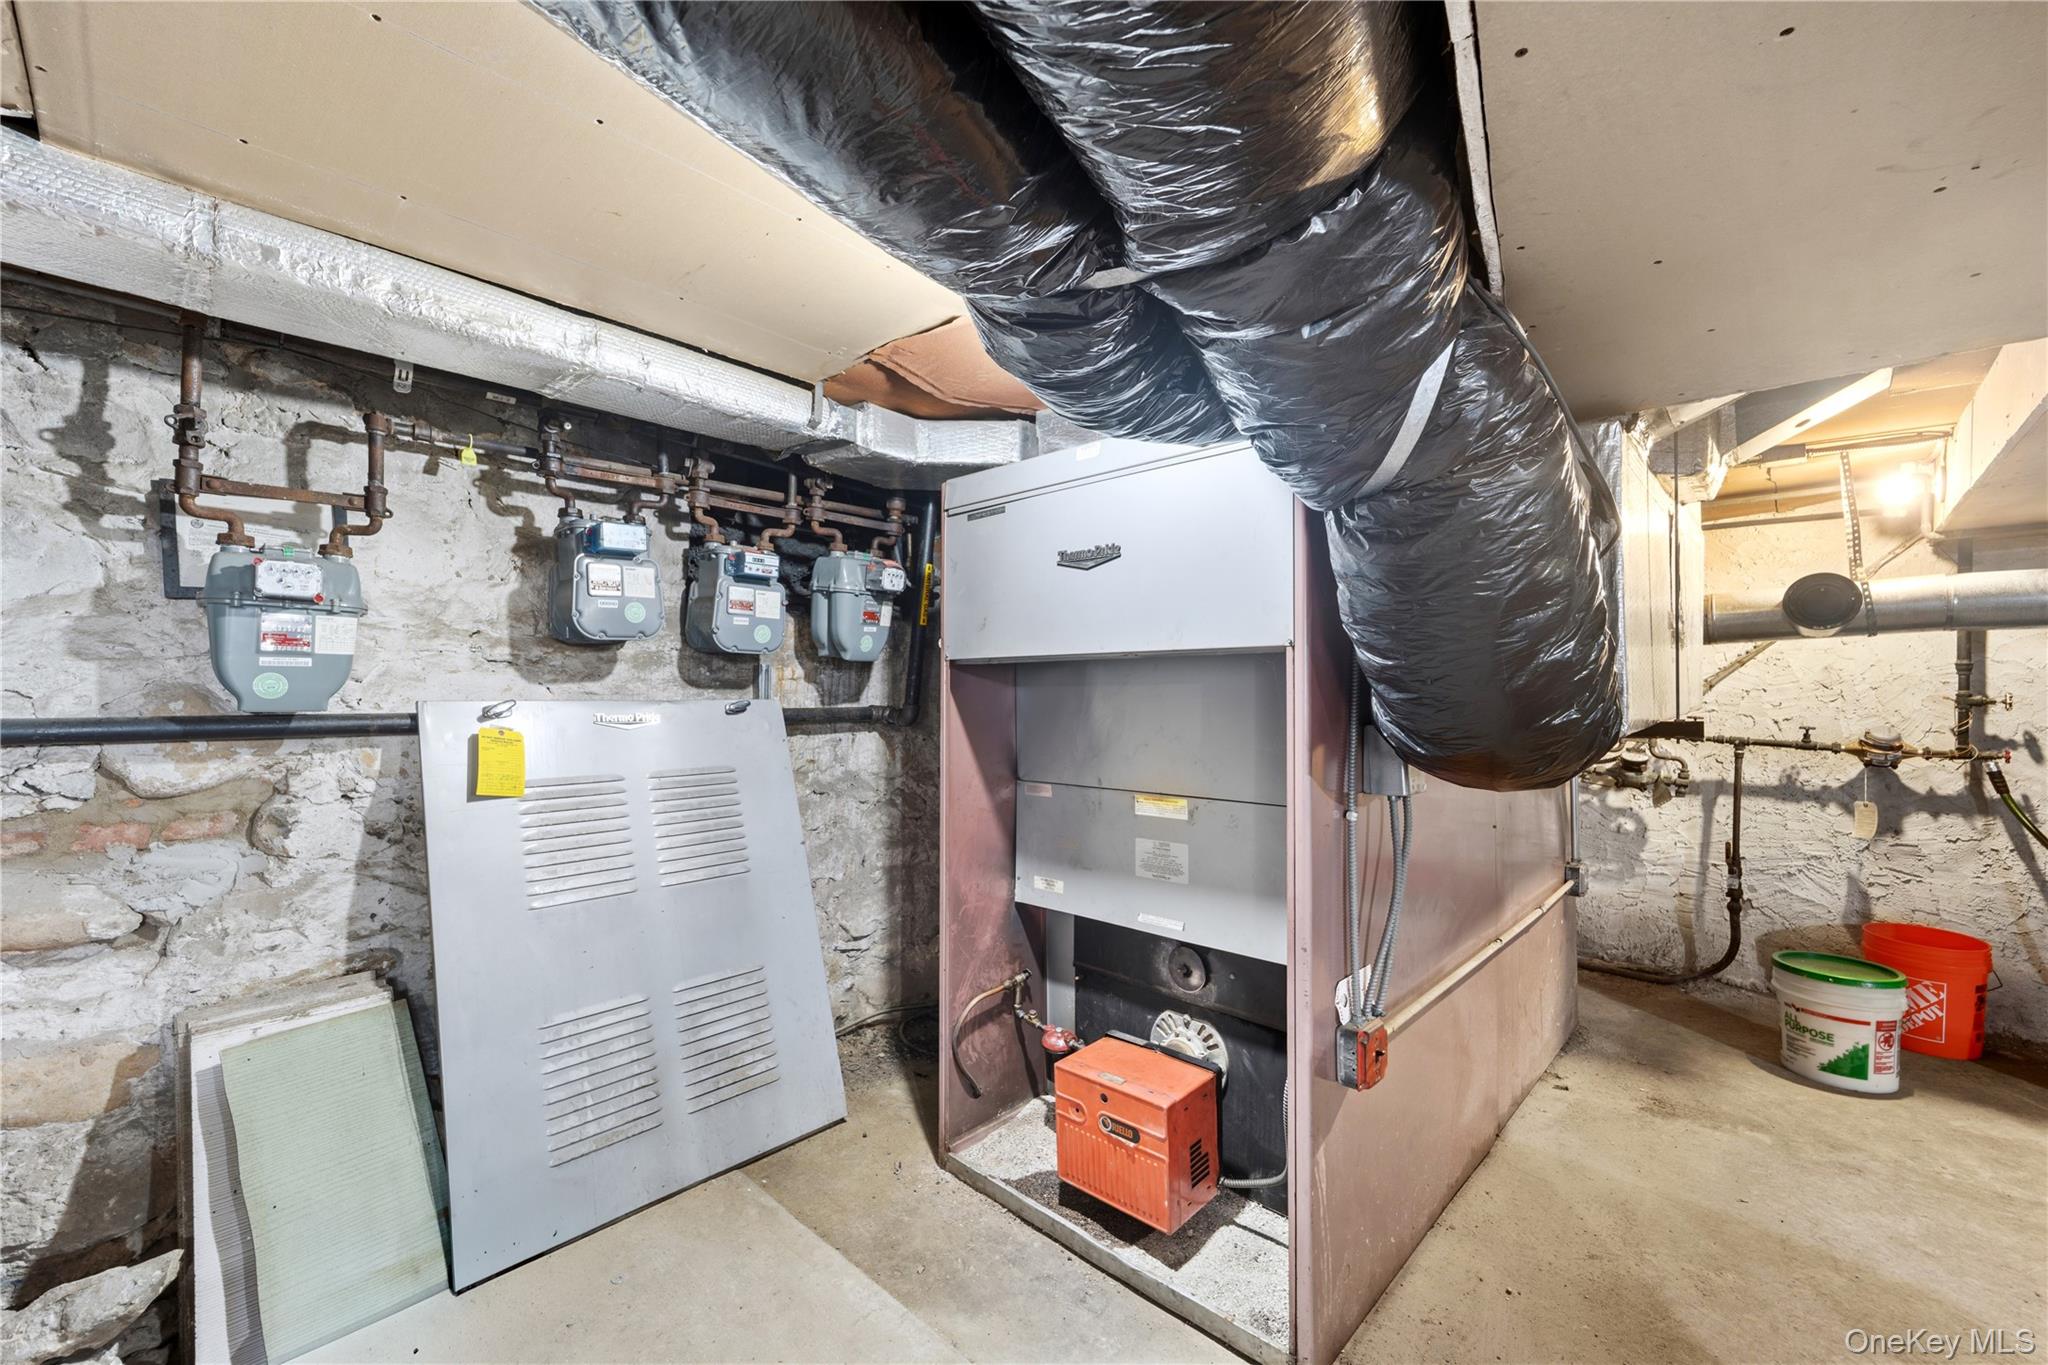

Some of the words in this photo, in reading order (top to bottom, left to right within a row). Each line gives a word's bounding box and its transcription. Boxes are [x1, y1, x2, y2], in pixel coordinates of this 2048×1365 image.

[593, 712, 633, 722] Thermo
[1785, 1010, 1800, 1025] ALL
[1901, 1004, 1944, 1032] DEPOT
[1785, 1018, 1834, 1042] PURPOSE
